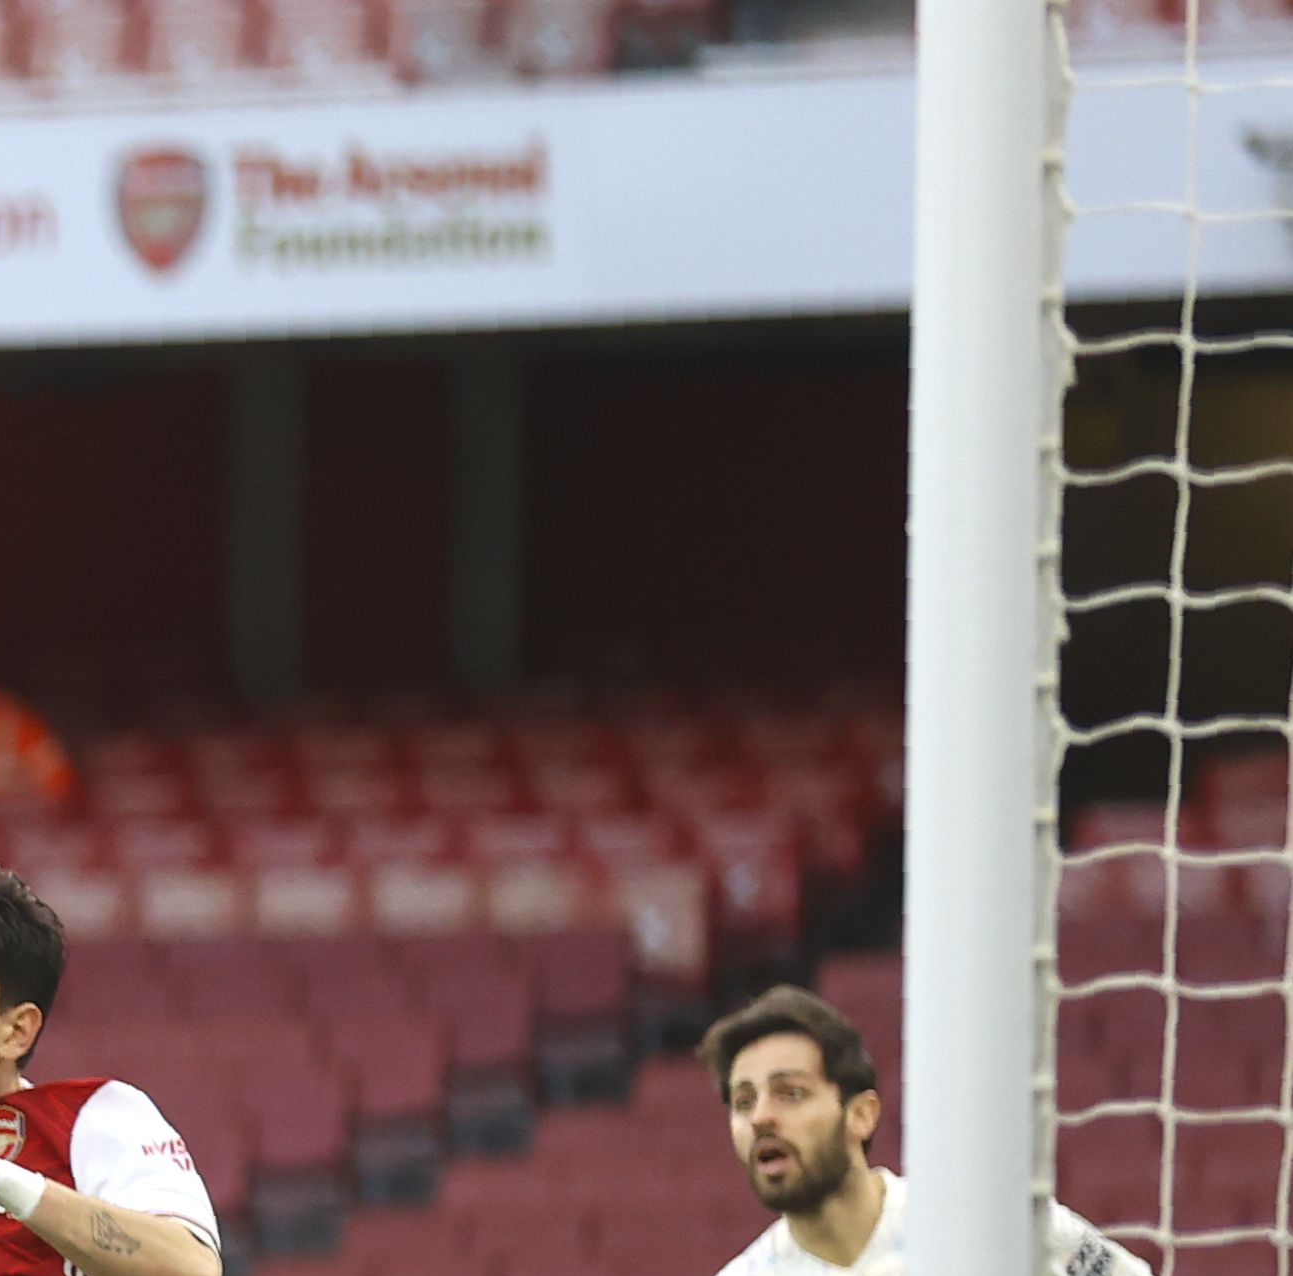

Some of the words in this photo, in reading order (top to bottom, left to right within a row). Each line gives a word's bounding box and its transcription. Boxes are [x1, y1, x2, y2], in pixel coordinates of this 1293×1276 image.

[232, 140, 320, 204] The
[344, 132, 548, 202] Arsenal
[232, 210, 552, 272] Foundation
